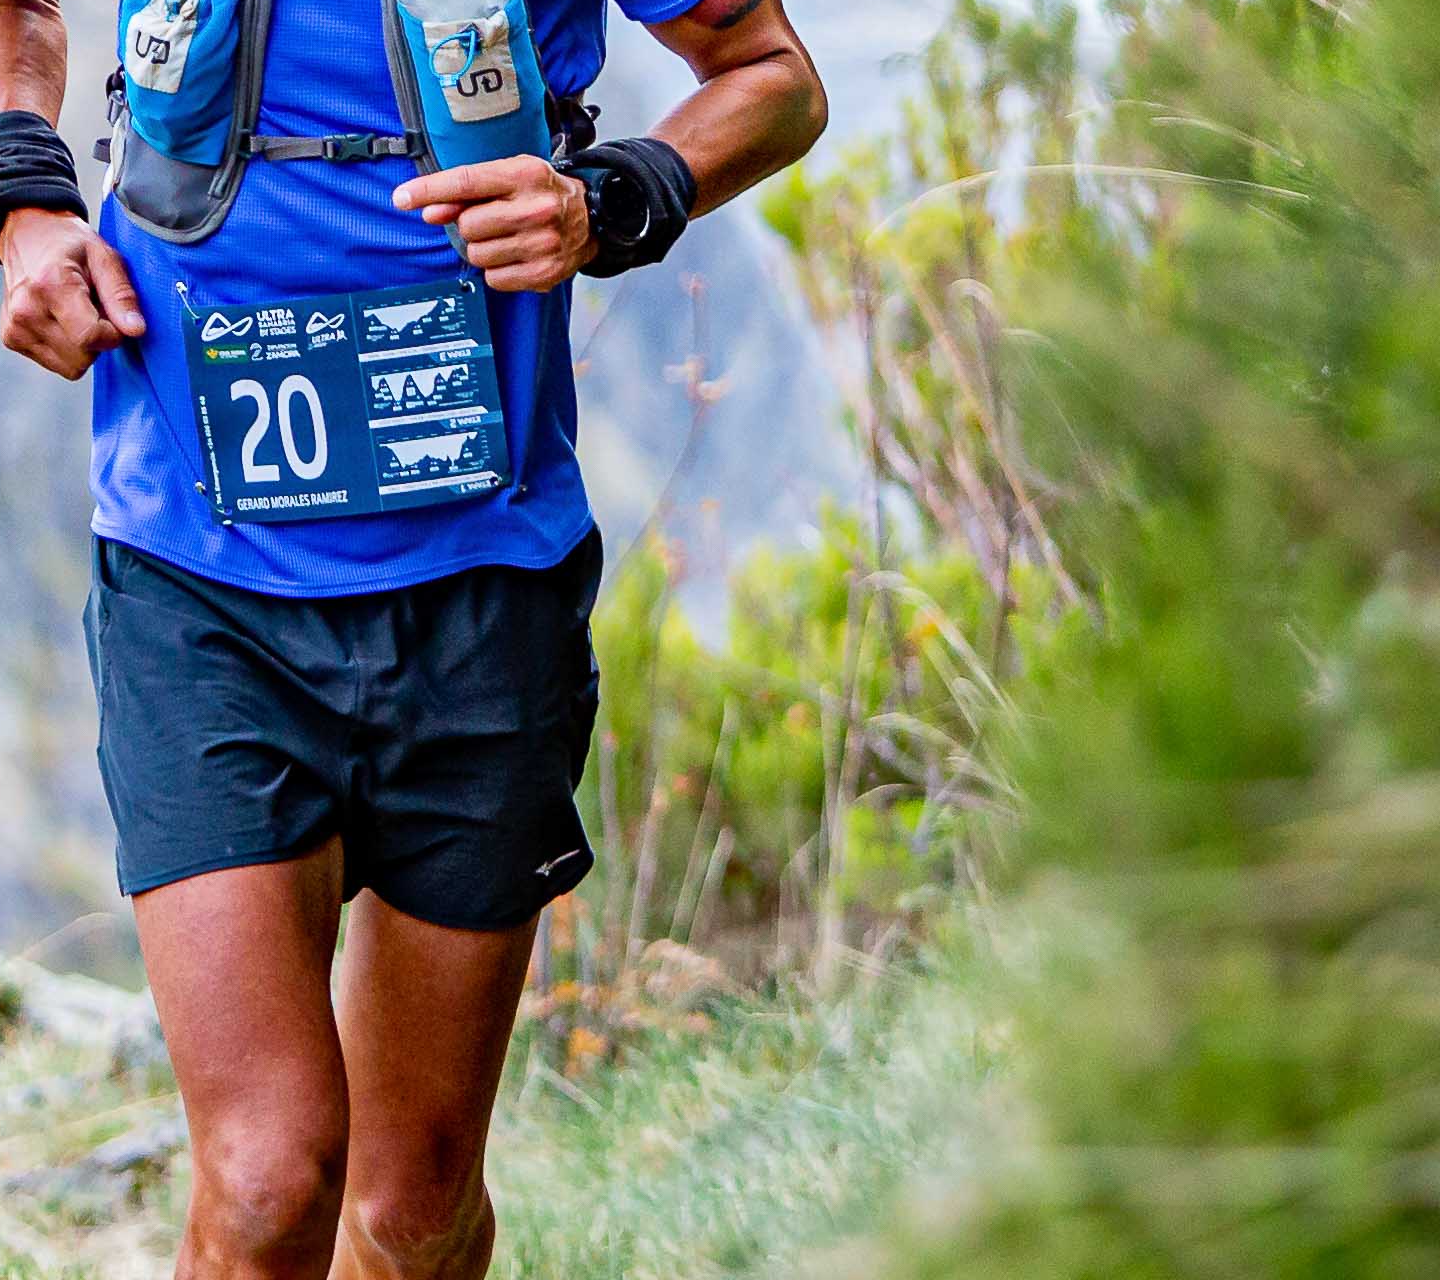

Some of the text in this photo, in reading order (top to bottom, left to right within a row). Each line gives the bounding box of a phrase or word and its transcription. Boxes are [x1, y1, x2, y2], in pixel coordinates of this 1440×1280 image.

[256, 308, 295, 321] ULTRA
[229, 374, 328, 483] 20
[237, 489, 348, 511] GERARD MORALES RAMIREZ
